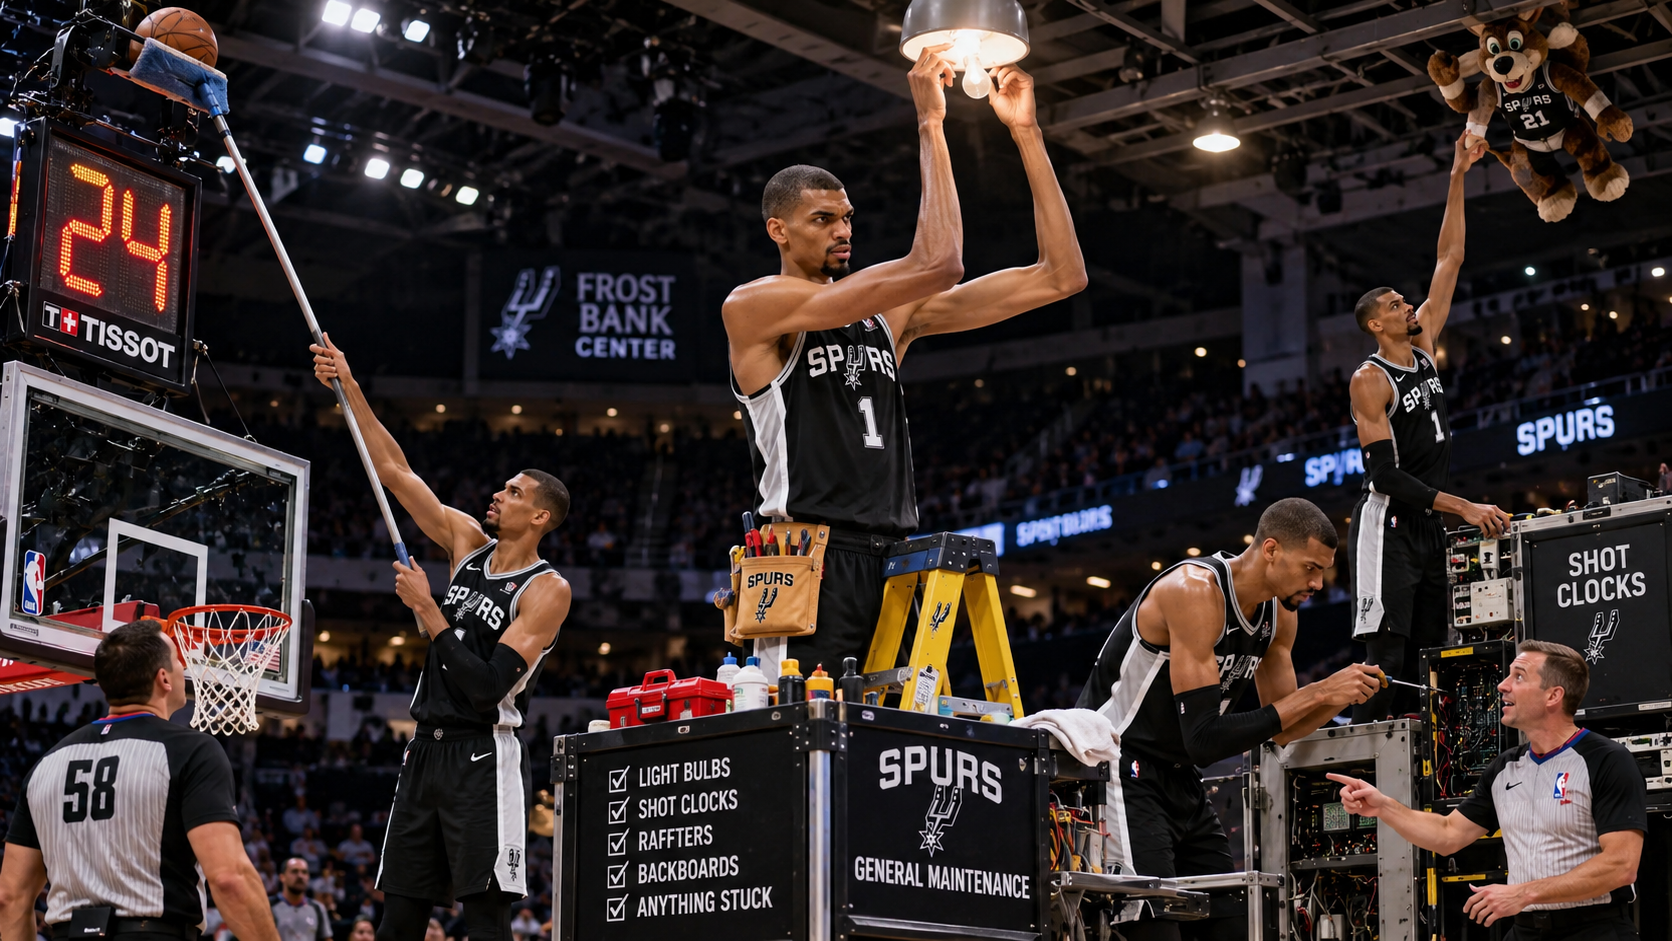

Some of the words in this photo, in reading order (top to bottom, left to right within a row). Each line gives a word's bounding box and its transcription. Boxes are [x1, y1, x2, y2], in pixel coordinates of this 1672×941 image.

[1504, 94, 1552, 112] SPURS
[1520, 110, 1551, 130] 21
[60, 163, 172, 312] 24
[577, 272, 676, 304] FROST
[579, 303, 673, 335] BANK
[80, 314, 176, 368] TISSOT
[575, 336, 676, 360] CENTER
[808, 344, 896, 389] SPURS
[857, 395, 885, 450] 1
[1431, 410, 1446, 443] 1
[1516, 404, 1615, 456] SPURS
[1305, 448, 1365, 487] SPUR
[1568, 544, 1631, 577] SHOT
[747, 571, 794, 588] SPURS
[1557, 572, 1647, 608] CLOCKS
[444, 585, 505, 630] SPURS
[639, 764, 680, 787] LIGHT
[684, 757, 731, 782] BULBS
[879, 745, 1002, 804] SPURS
[63, 755, 119, 823] 58
[638, 796, 677, 819] SHOT
[681, 789, 738, 814] CLOCKS
[638, 824, 713, 851] RAFFTERS
[638, 855, 739, 884] BACKBOARDS
[854, 856, 923, 888] GENERAL
[928, 864, 1030, 899] MAINTENANCE
[637, 891, 715, 918] ANYTHING
[720, 886, 773, 912] STUCK
